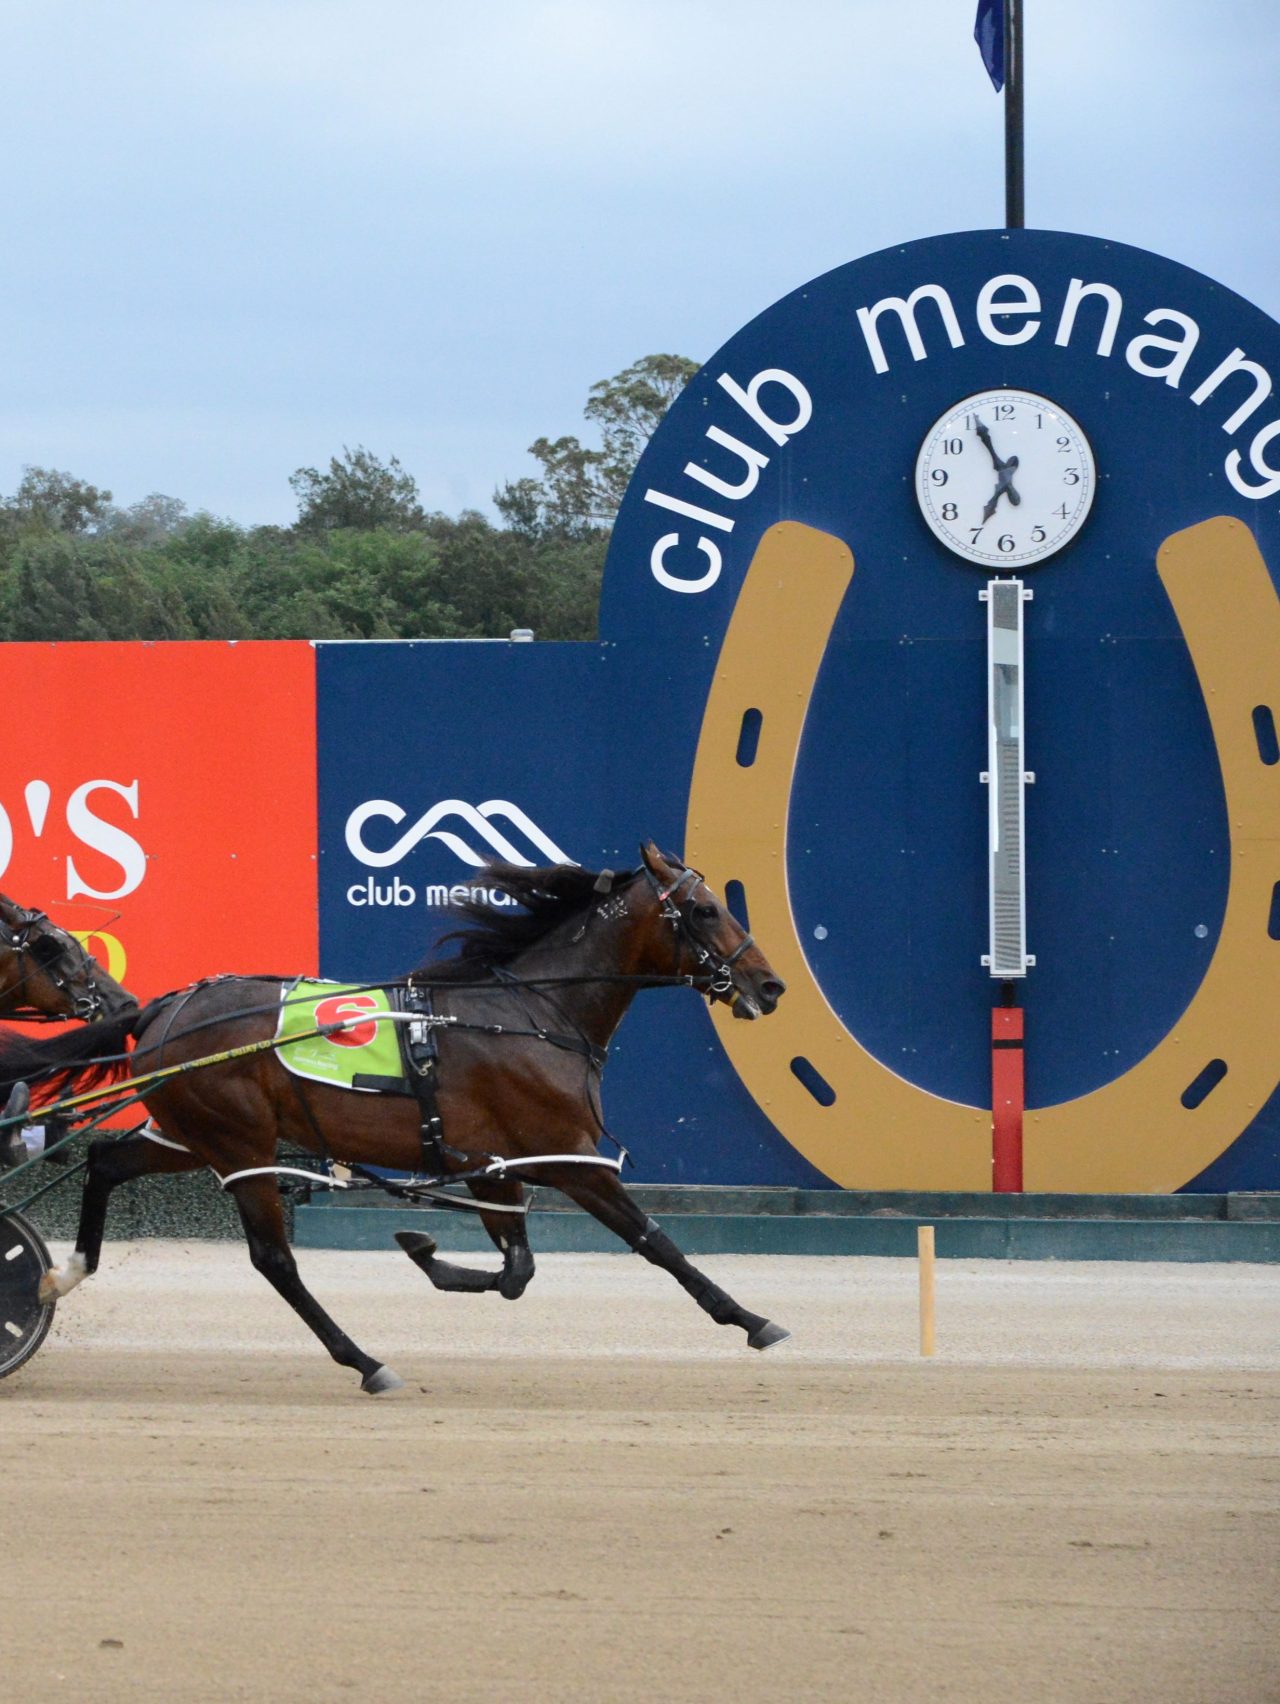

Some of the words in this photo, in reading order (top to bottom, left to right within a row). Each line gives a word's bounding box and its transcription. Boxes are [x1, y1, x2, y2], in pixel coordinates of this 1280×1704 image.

[993, 404, 1016, 421] 12
[1035, 413, 1043, 430] 1
[941, 438, 963, 455] 10
[1055, 436, 1071, 453] 2
[644, 369, 813, 594] club
[931, 469, 949, 487] 9
[1063, 467, 1080, 486] 3
[941, 502, 959, 521] 8
[1050, 501, 1071, 520] 4
[969, 527, 984, 545] 7
[1030, 525, 1046, 543] 5
[997, 534, 1016, 553] 6
[346, 876, 416, 907] club
[314, 995, 378, 1049] 6
